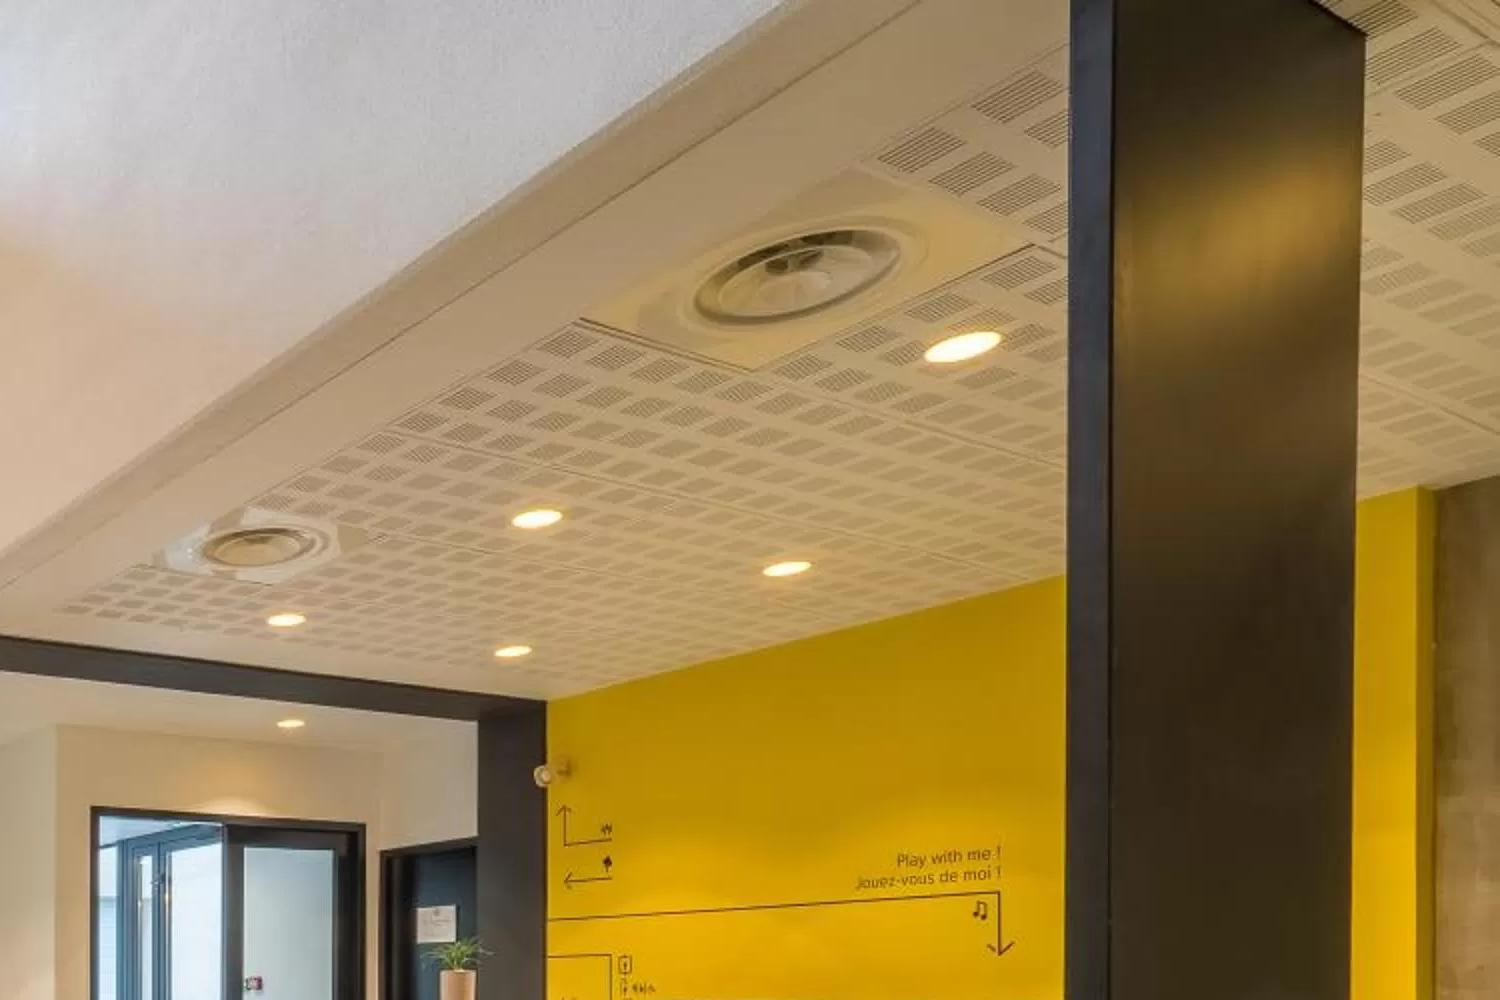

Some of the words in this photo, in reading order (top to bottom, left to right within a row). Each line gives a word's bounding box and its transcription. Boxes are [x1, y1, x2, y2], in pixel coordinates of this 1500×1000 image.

[897, 853, 927, 869] Play
[931, 849, 963, 865] with
[967, 849, 992, 861] me
[939, 870, 959, 883] de
[963, 865, 991, 881] moi
